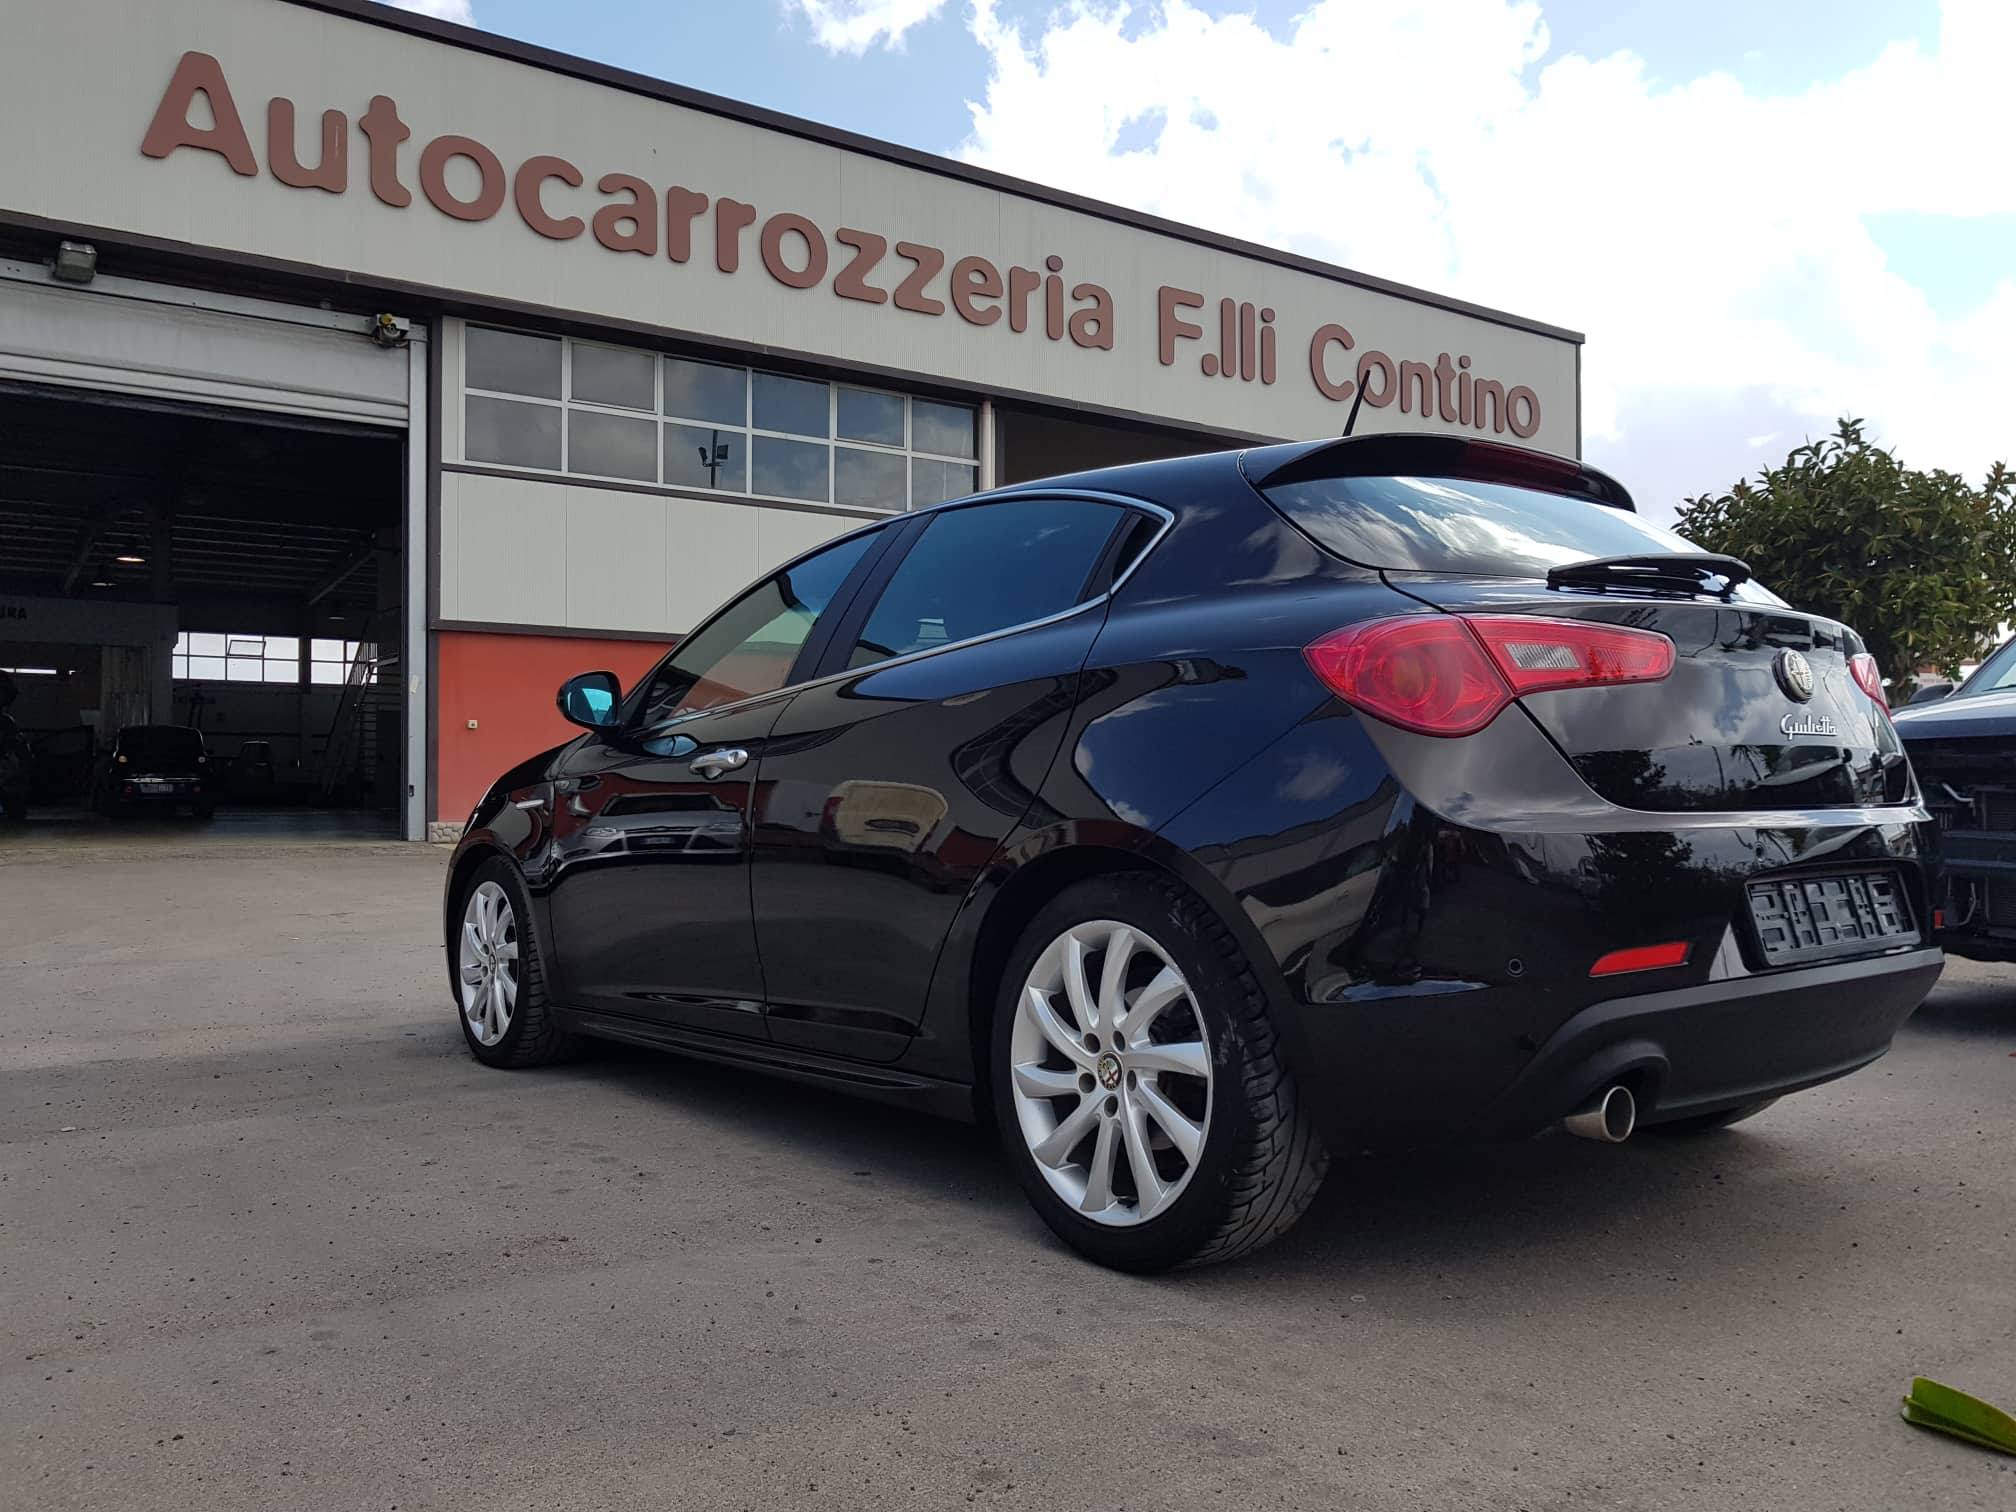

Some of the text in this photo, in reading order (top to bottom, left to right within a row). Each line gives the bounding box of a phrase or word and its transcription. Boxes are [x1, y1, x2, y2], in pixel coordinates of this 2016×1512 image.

[141, 51, 1541, 438] Autocarrozzeria F.lli Contino
[1780, 713, 1838, 741] Giulietta
